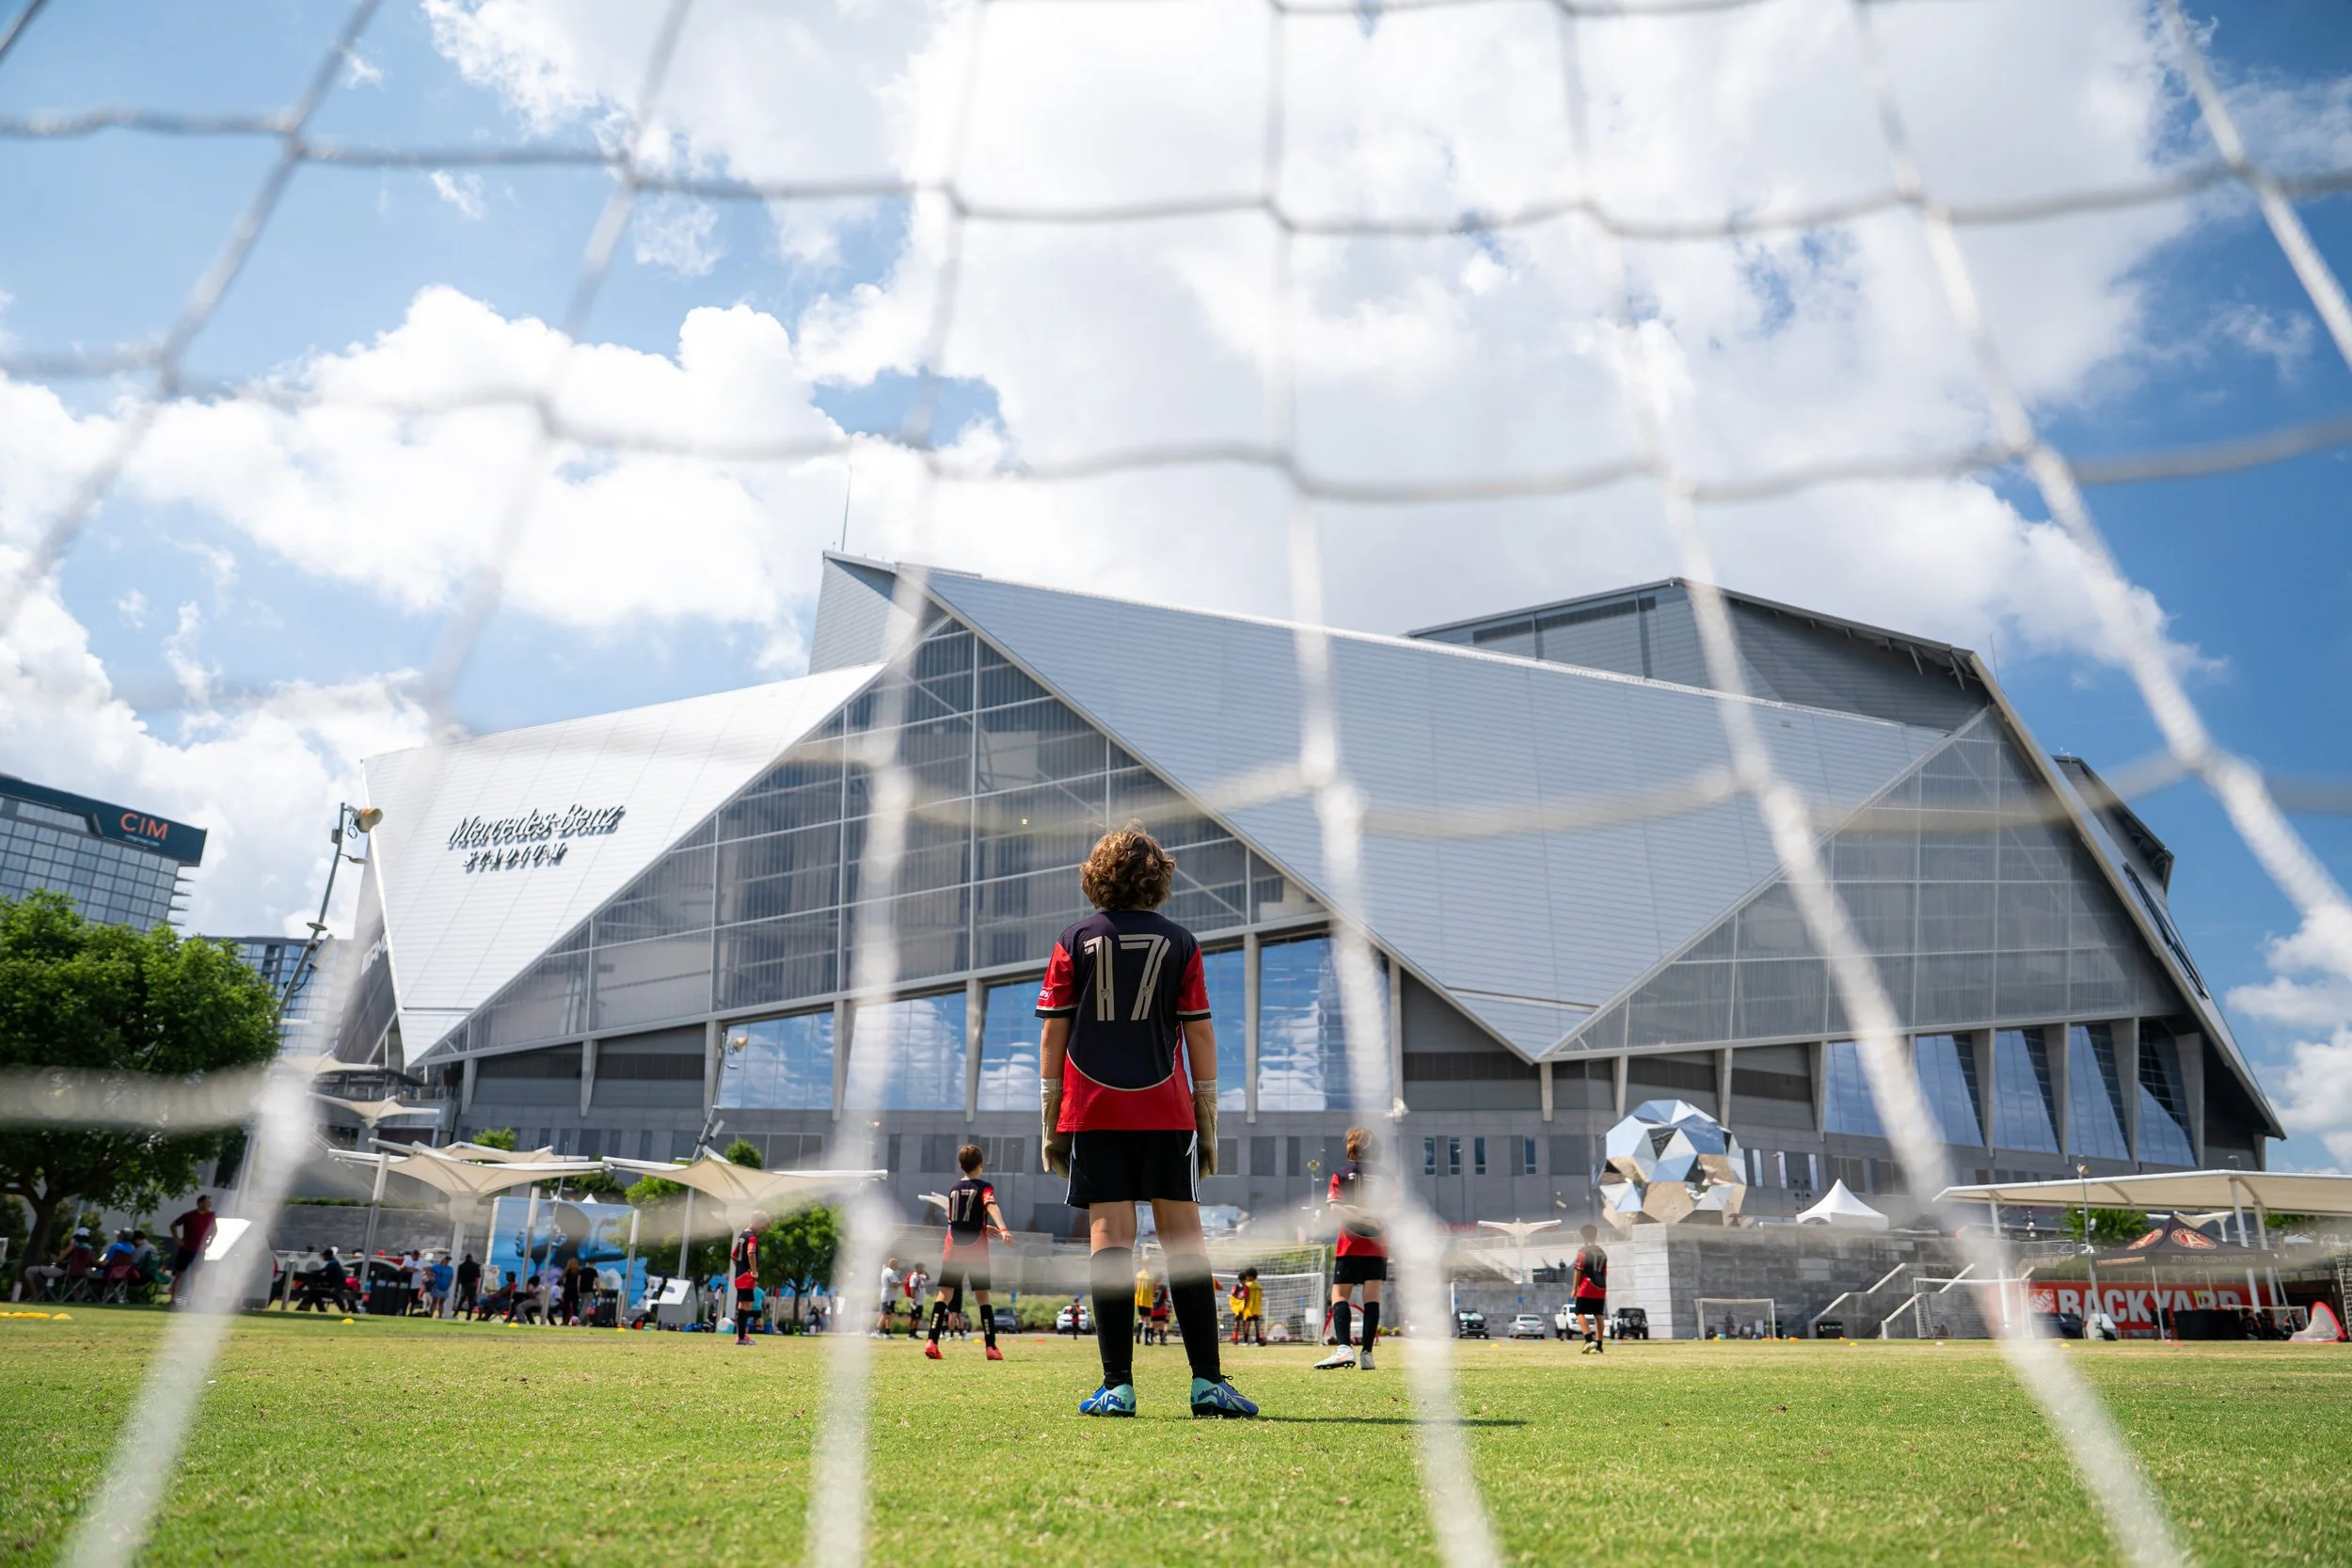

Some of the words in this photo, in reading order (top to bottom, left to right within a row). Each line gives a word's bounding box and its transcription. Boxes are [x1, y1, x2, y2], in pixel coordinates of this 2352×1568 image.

[120, 812, 169, 840] CIM
[446, 804, 626, 849] Mercedes-Benz
[463, 842, 567, 872] STADIUM
[1083, 933, 1171, 1022] 17
[950, 1188, 977, 1222] 17
[2058, 1289, 2242, 1322] BACKYARD
